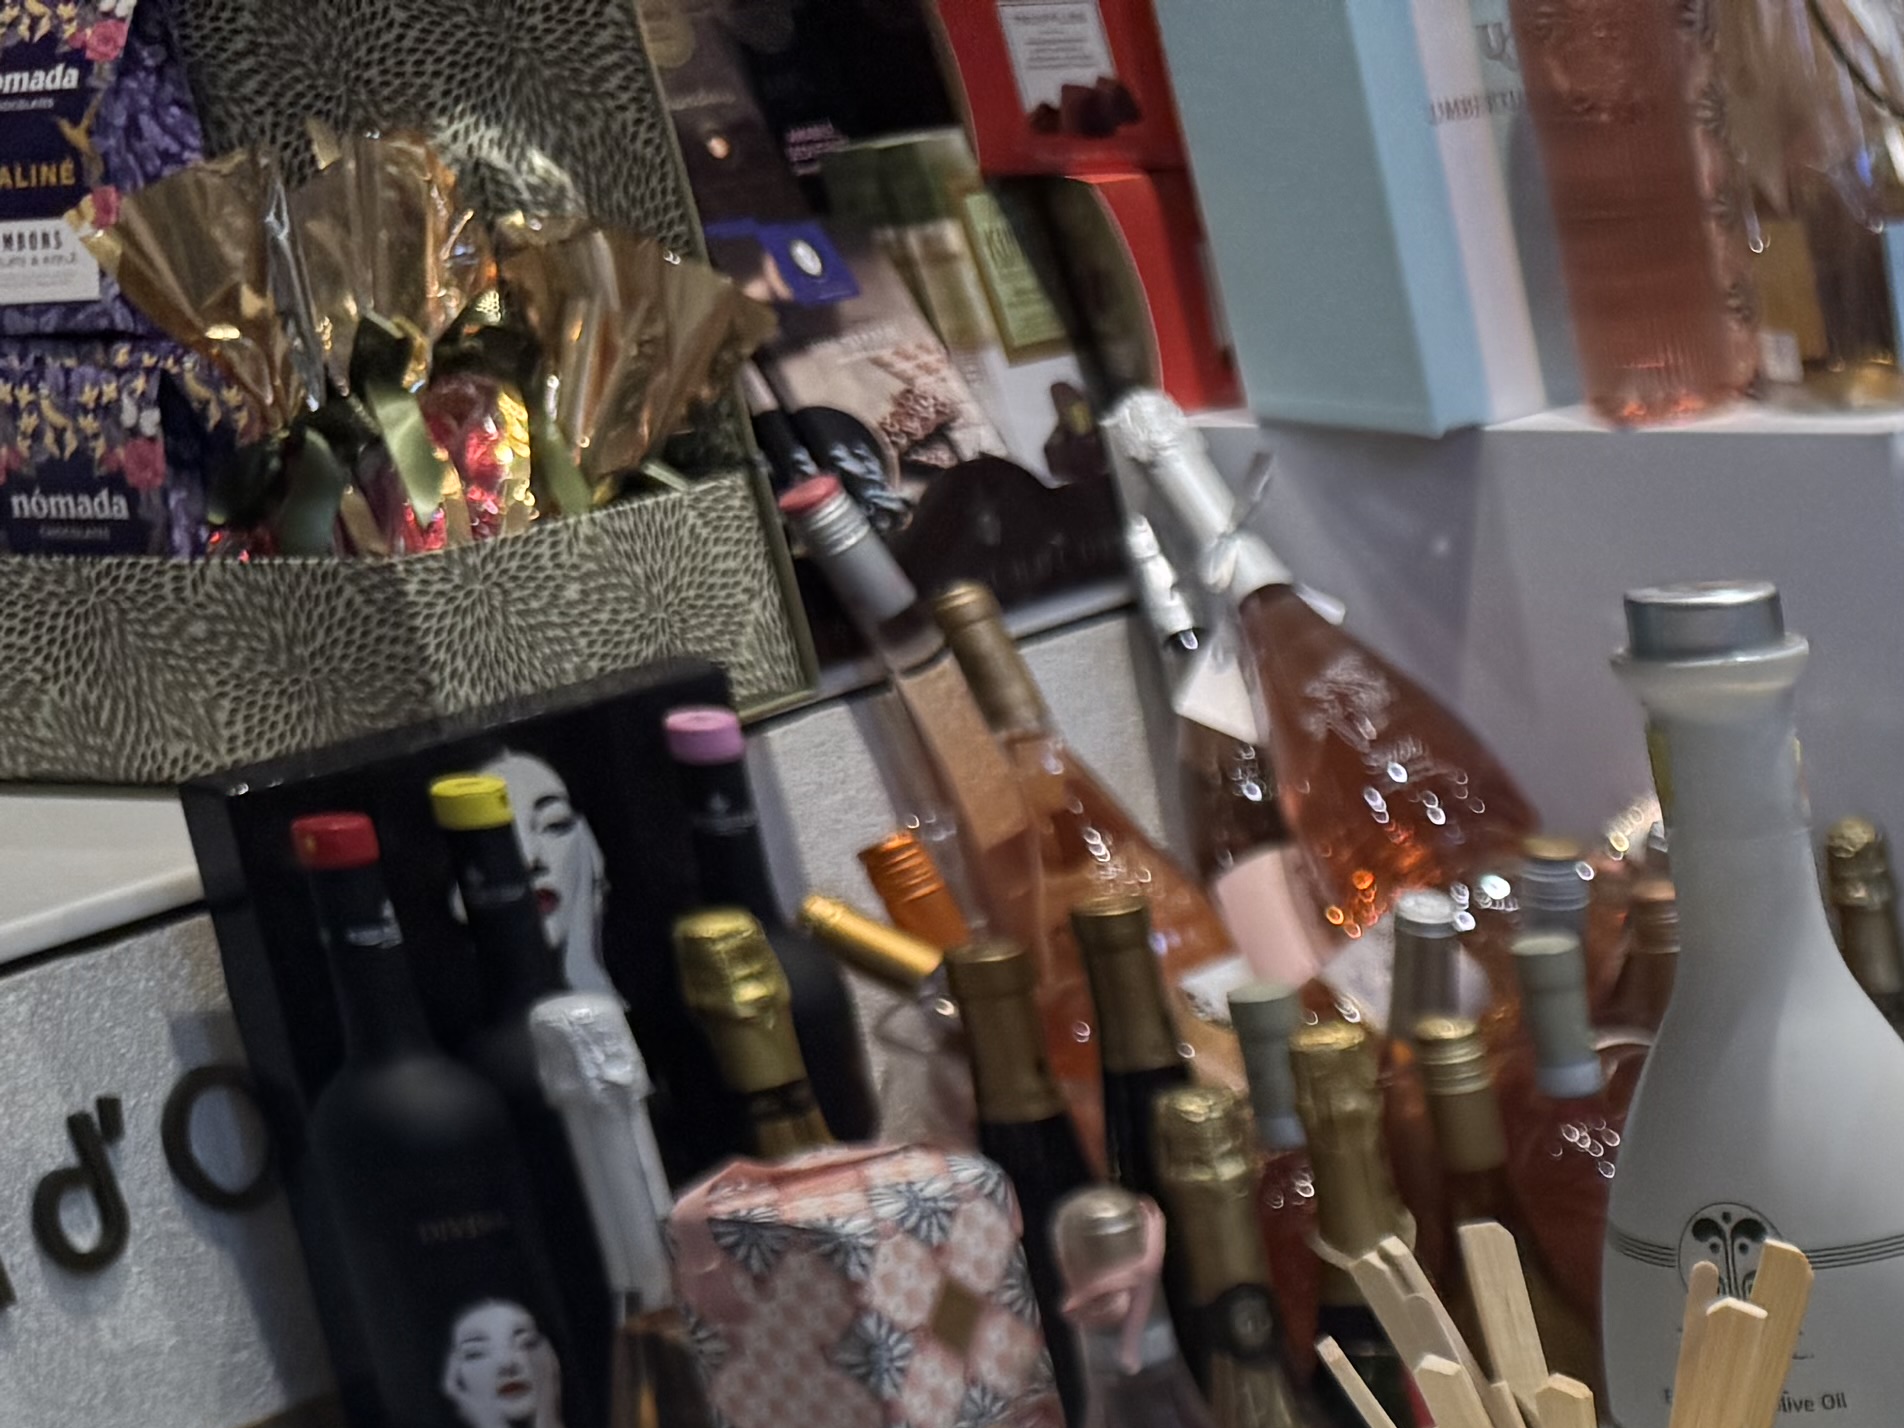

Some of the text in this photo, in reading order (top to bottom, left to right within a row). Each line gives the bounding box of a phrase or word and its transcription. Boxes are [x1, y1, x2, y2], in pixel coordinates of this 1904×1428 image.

[11, 486, 130, 520] nómada
[1776, 1390, 1848, 1413] live Oil
